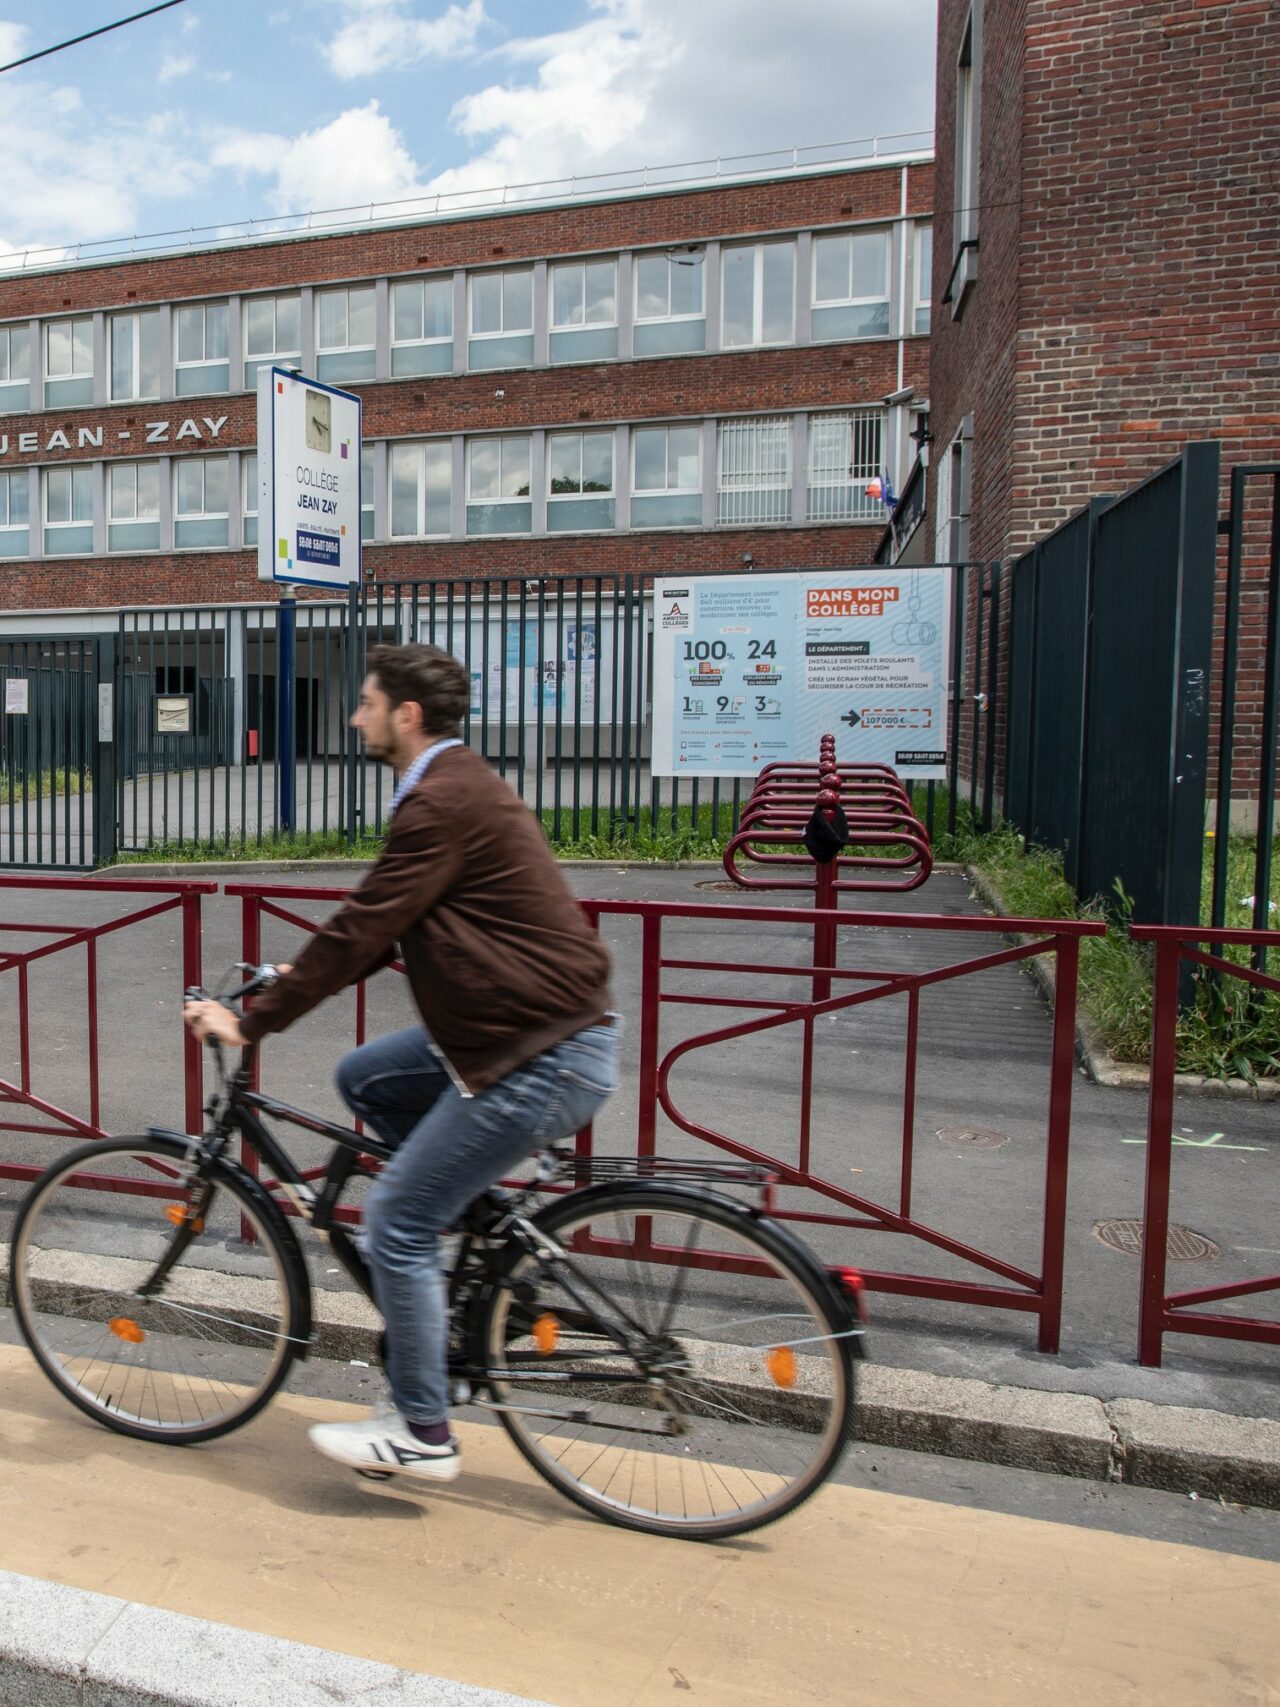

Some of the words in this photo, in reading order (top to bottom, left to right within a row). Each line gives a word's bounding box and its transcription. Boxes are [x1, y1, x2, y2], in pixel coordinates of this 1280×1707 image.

[296, 466, 339, 493] COLLÈGE
[297, 493, 320, 511] JEAN
[321, 499, 338, 515] ZAY
[809, 590, 852, 602] DANS
[857, 589, 895, 601] MON
[808, 601, 880, 616] COLLÈGE
[747, 639, 777, 660] 24
[808, 682, 845, 690] SÉCURISER
[683, 696, 692, 712] 1
[716, 696, 729, 712] 9
[754, 695, 766, 712] 3
